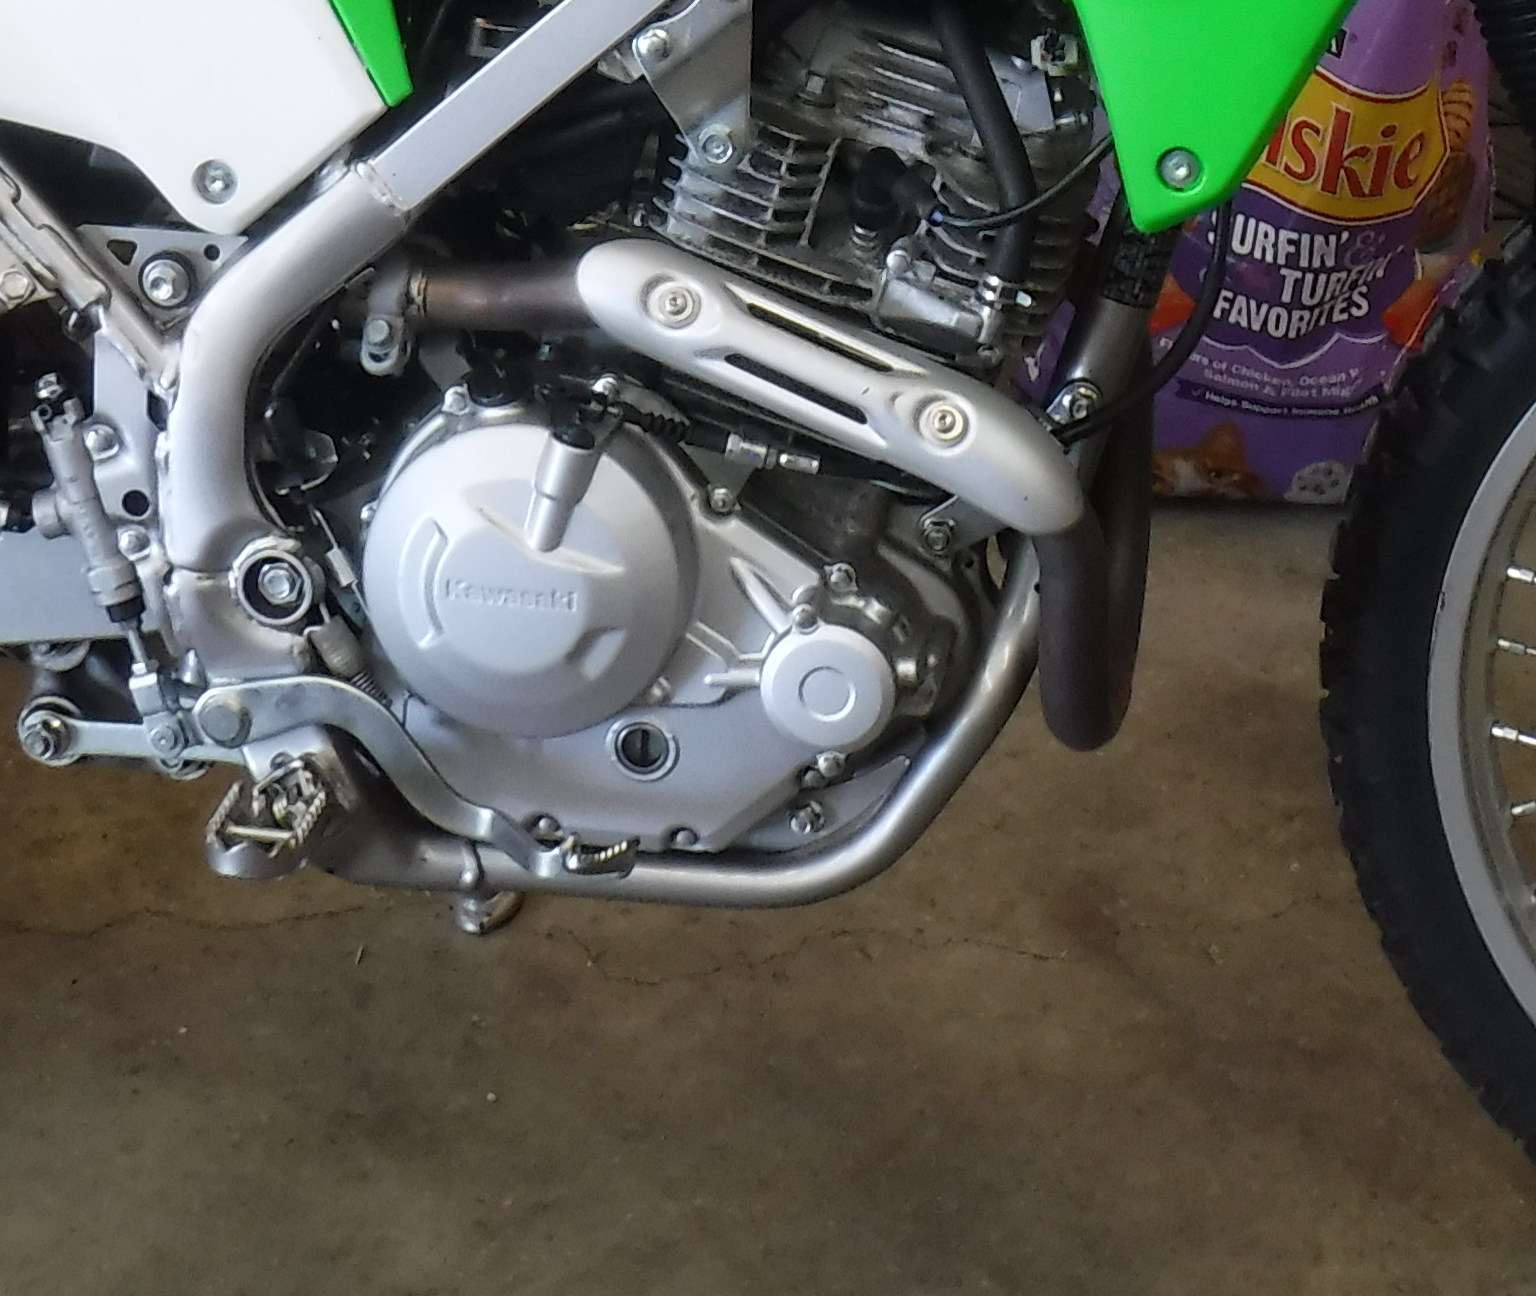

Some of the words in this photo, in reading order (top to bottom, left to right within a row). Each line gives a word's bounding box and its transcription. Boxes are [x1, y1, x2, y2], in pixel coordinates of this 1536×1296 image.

[1212, 285, 1370, 340] FAVORITES
[1203, 368, 1259, 392] Salmon
[1299, 370, 1347, 387] Ocean
[1204, 390, 1239, 407] Helps
[1241, 398, 1288, 415] Support
[445, 578, 578, 613] Kawasaki
